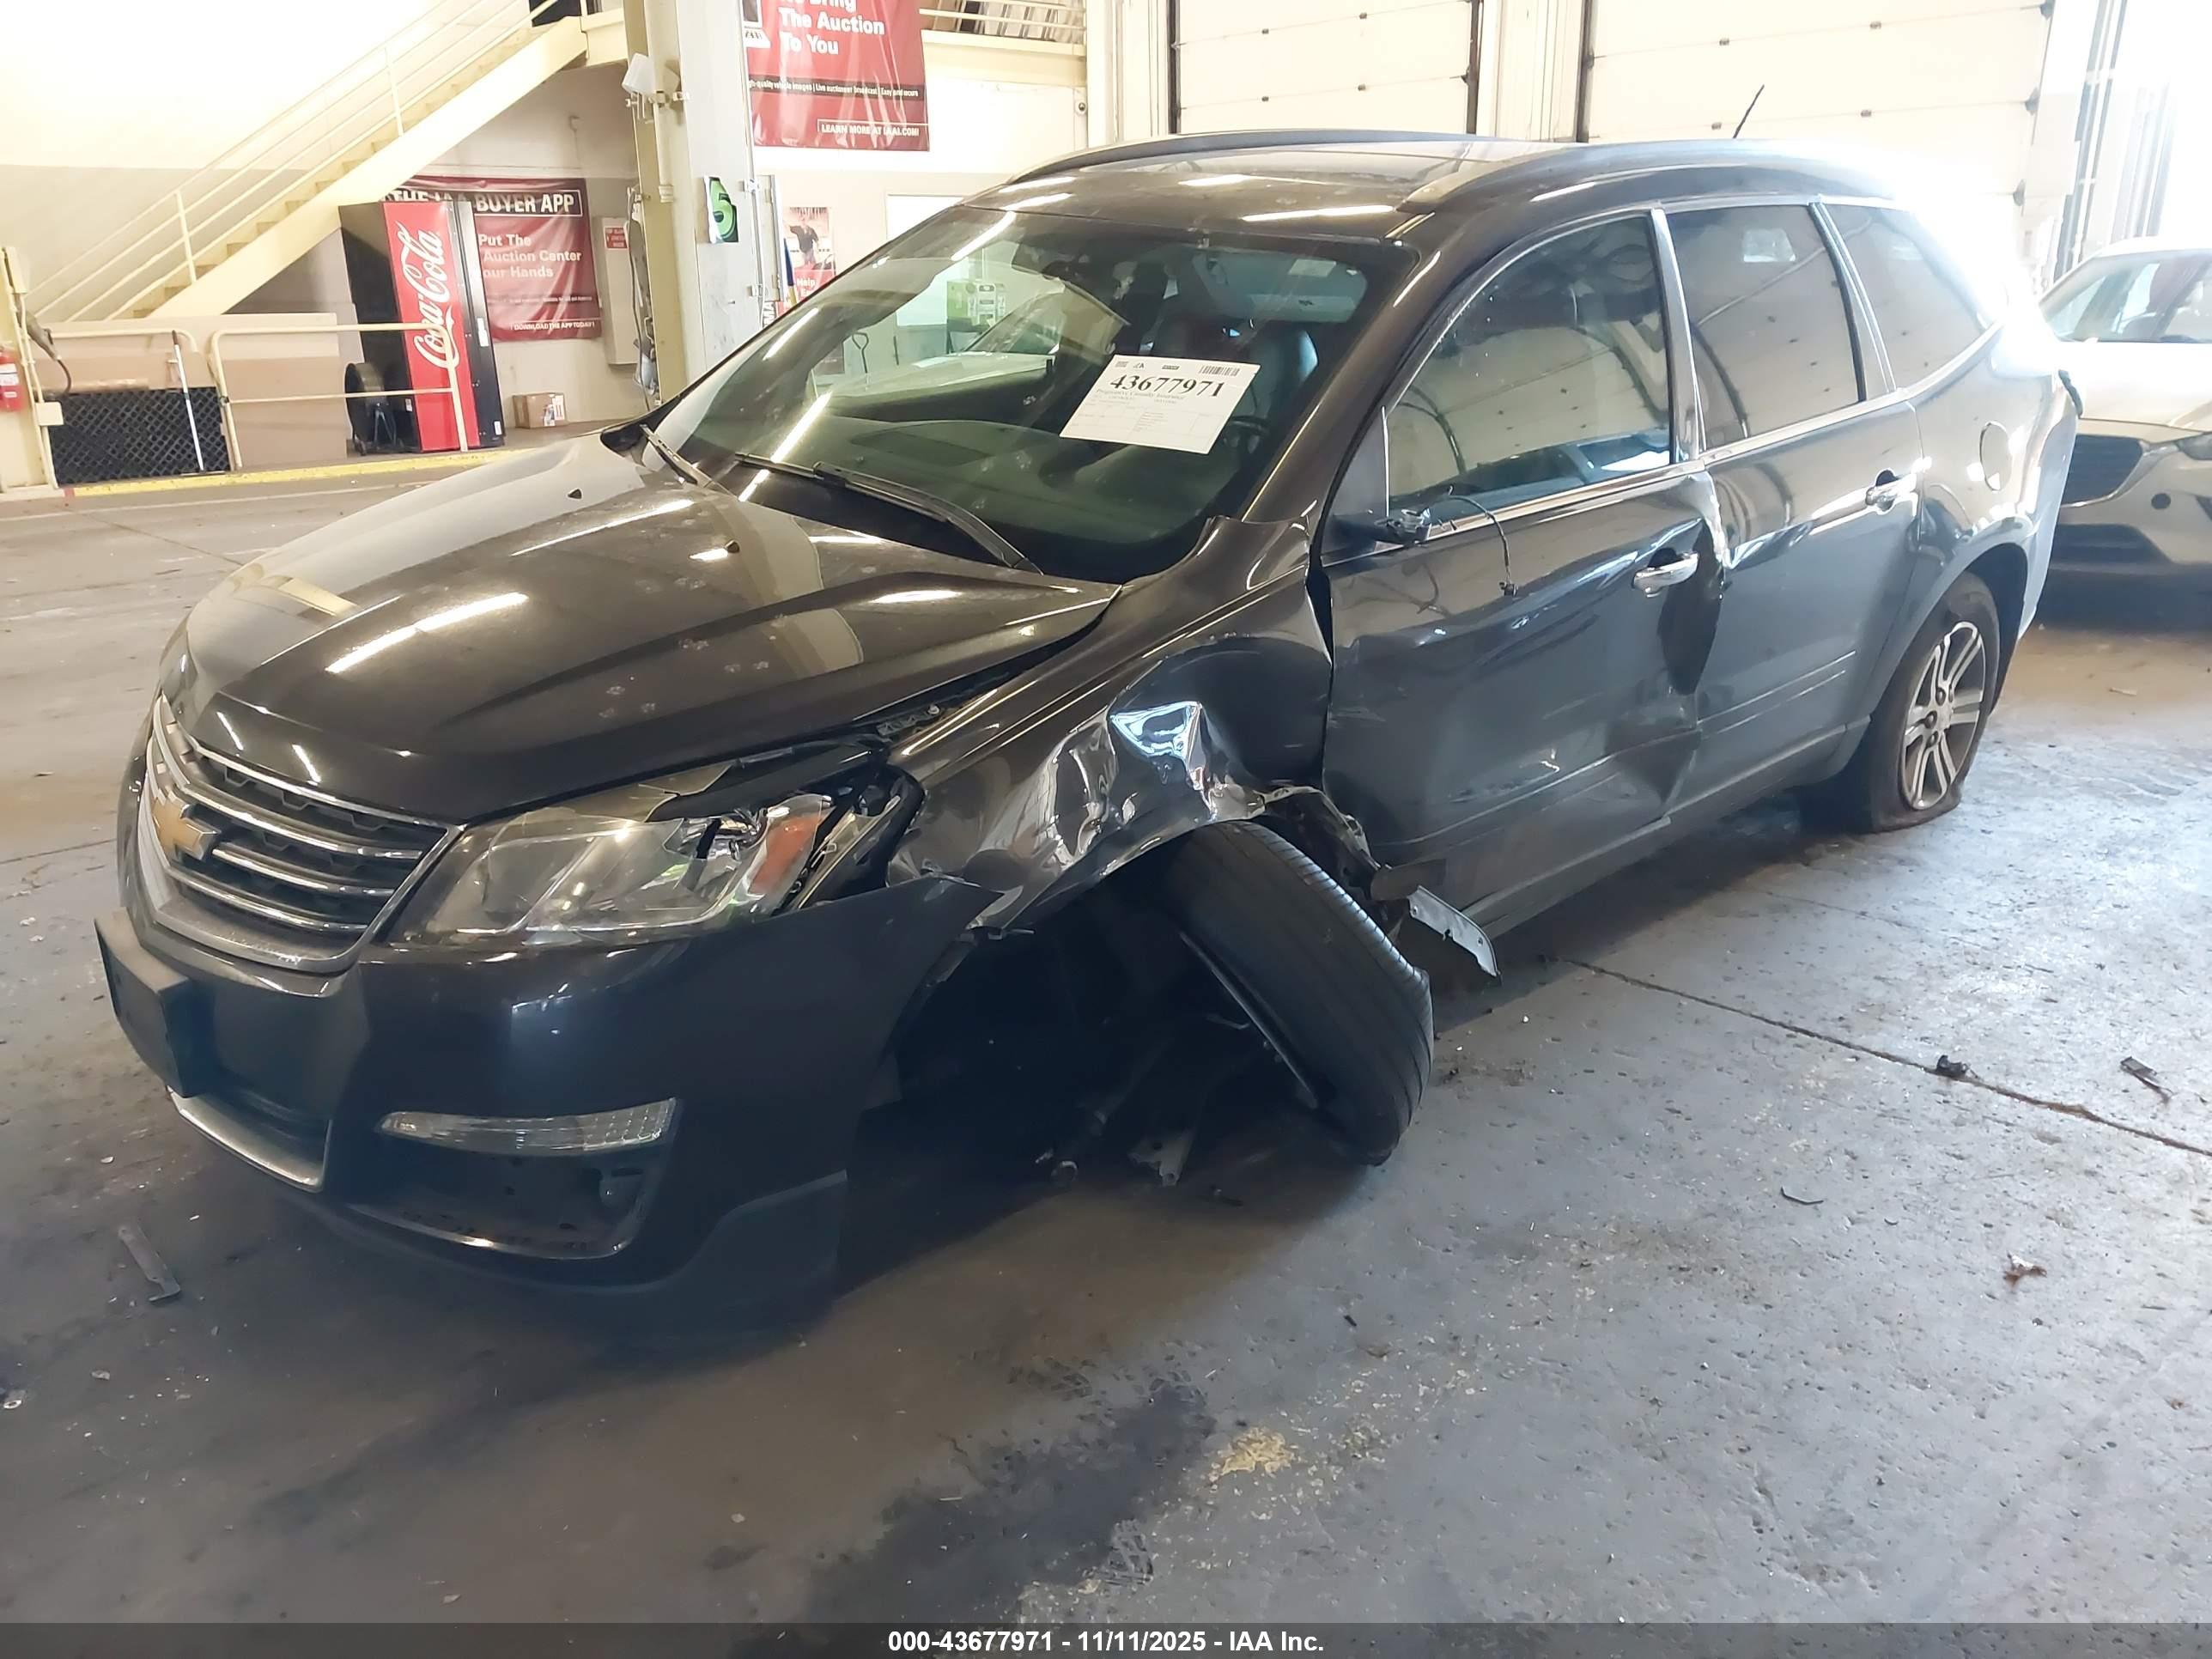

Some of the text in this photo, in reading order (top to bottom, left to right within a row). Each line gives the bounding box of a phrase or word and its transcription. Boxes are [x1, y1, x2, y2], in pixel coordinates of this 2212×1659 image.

[778, 7, 884, 34] The Auction
[780, 31, 802, 52] To
[807, 34, 839, 55] You
[821, 124, 848, 133] LEARN
[849, 125, 870, 134] MORE
[872, 126, 882, 135] AT
[476, 193, 536, 213] BUYER
[541, 194, 574, 213] APP
[478, 234, 532, 246] Put The
[483, 250, 582, 261] Auction Center
[483, 265, 554, 278] our Hands
[1110, 374, 1225, 397] 43677971
